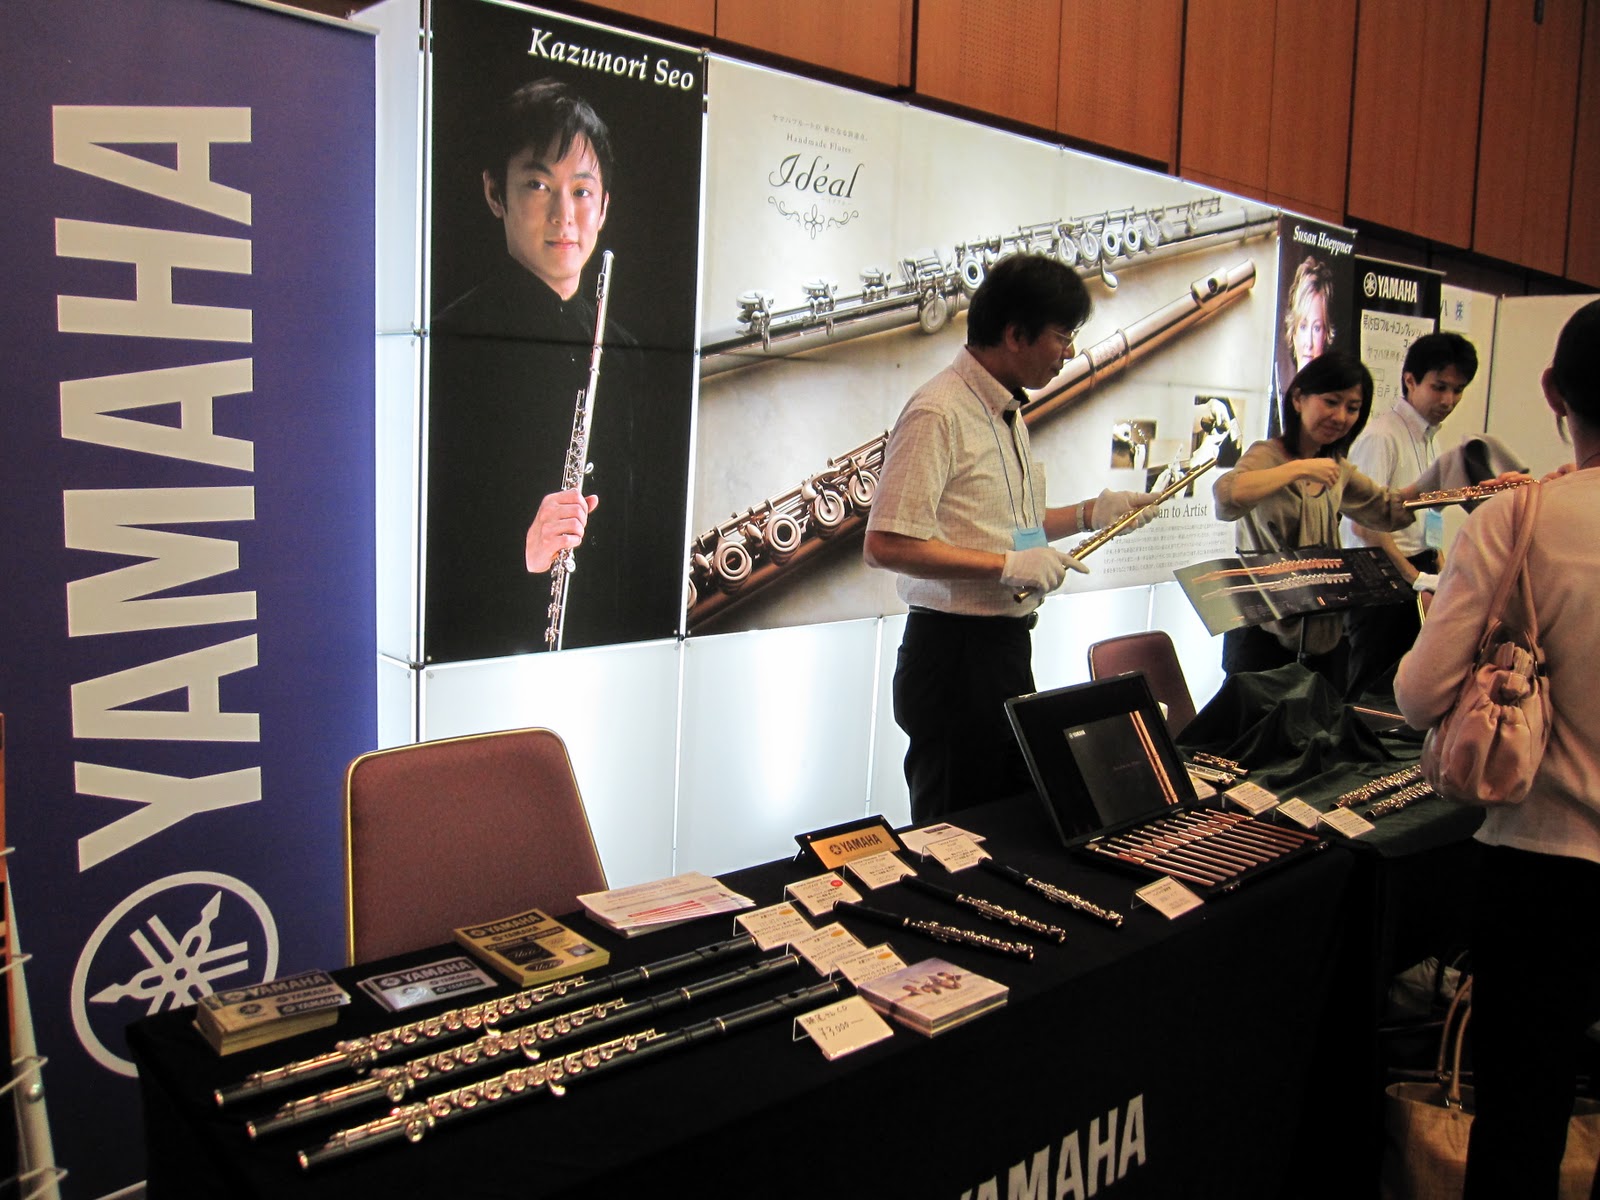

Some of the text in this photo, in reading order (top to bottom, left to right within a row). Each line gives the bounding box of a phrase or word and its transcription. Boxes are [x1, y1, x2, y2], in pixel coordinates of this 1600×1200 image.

[527, 28, 694, 91] Kazunori Seo
[768, 153, 865, 198] Idéal
[1293, 225, 1353, 256] Susan Hoeppner
[1377, 275, 1418, 304] YAMAHA
[52, 105, 262, 873] YAMAHA
[1172, 506, 1180, 518] to
[1183, 503, 1207, 518] Artist
[840, 834, 882, 853] YAMAHA
[484, 913, 542, 934] YAMAHA
[246, 974, 328, 998] YAMAHA
[401, 961, 471, 983] YAMAHA
[960, 1093, 1146, 1200] MAHA
